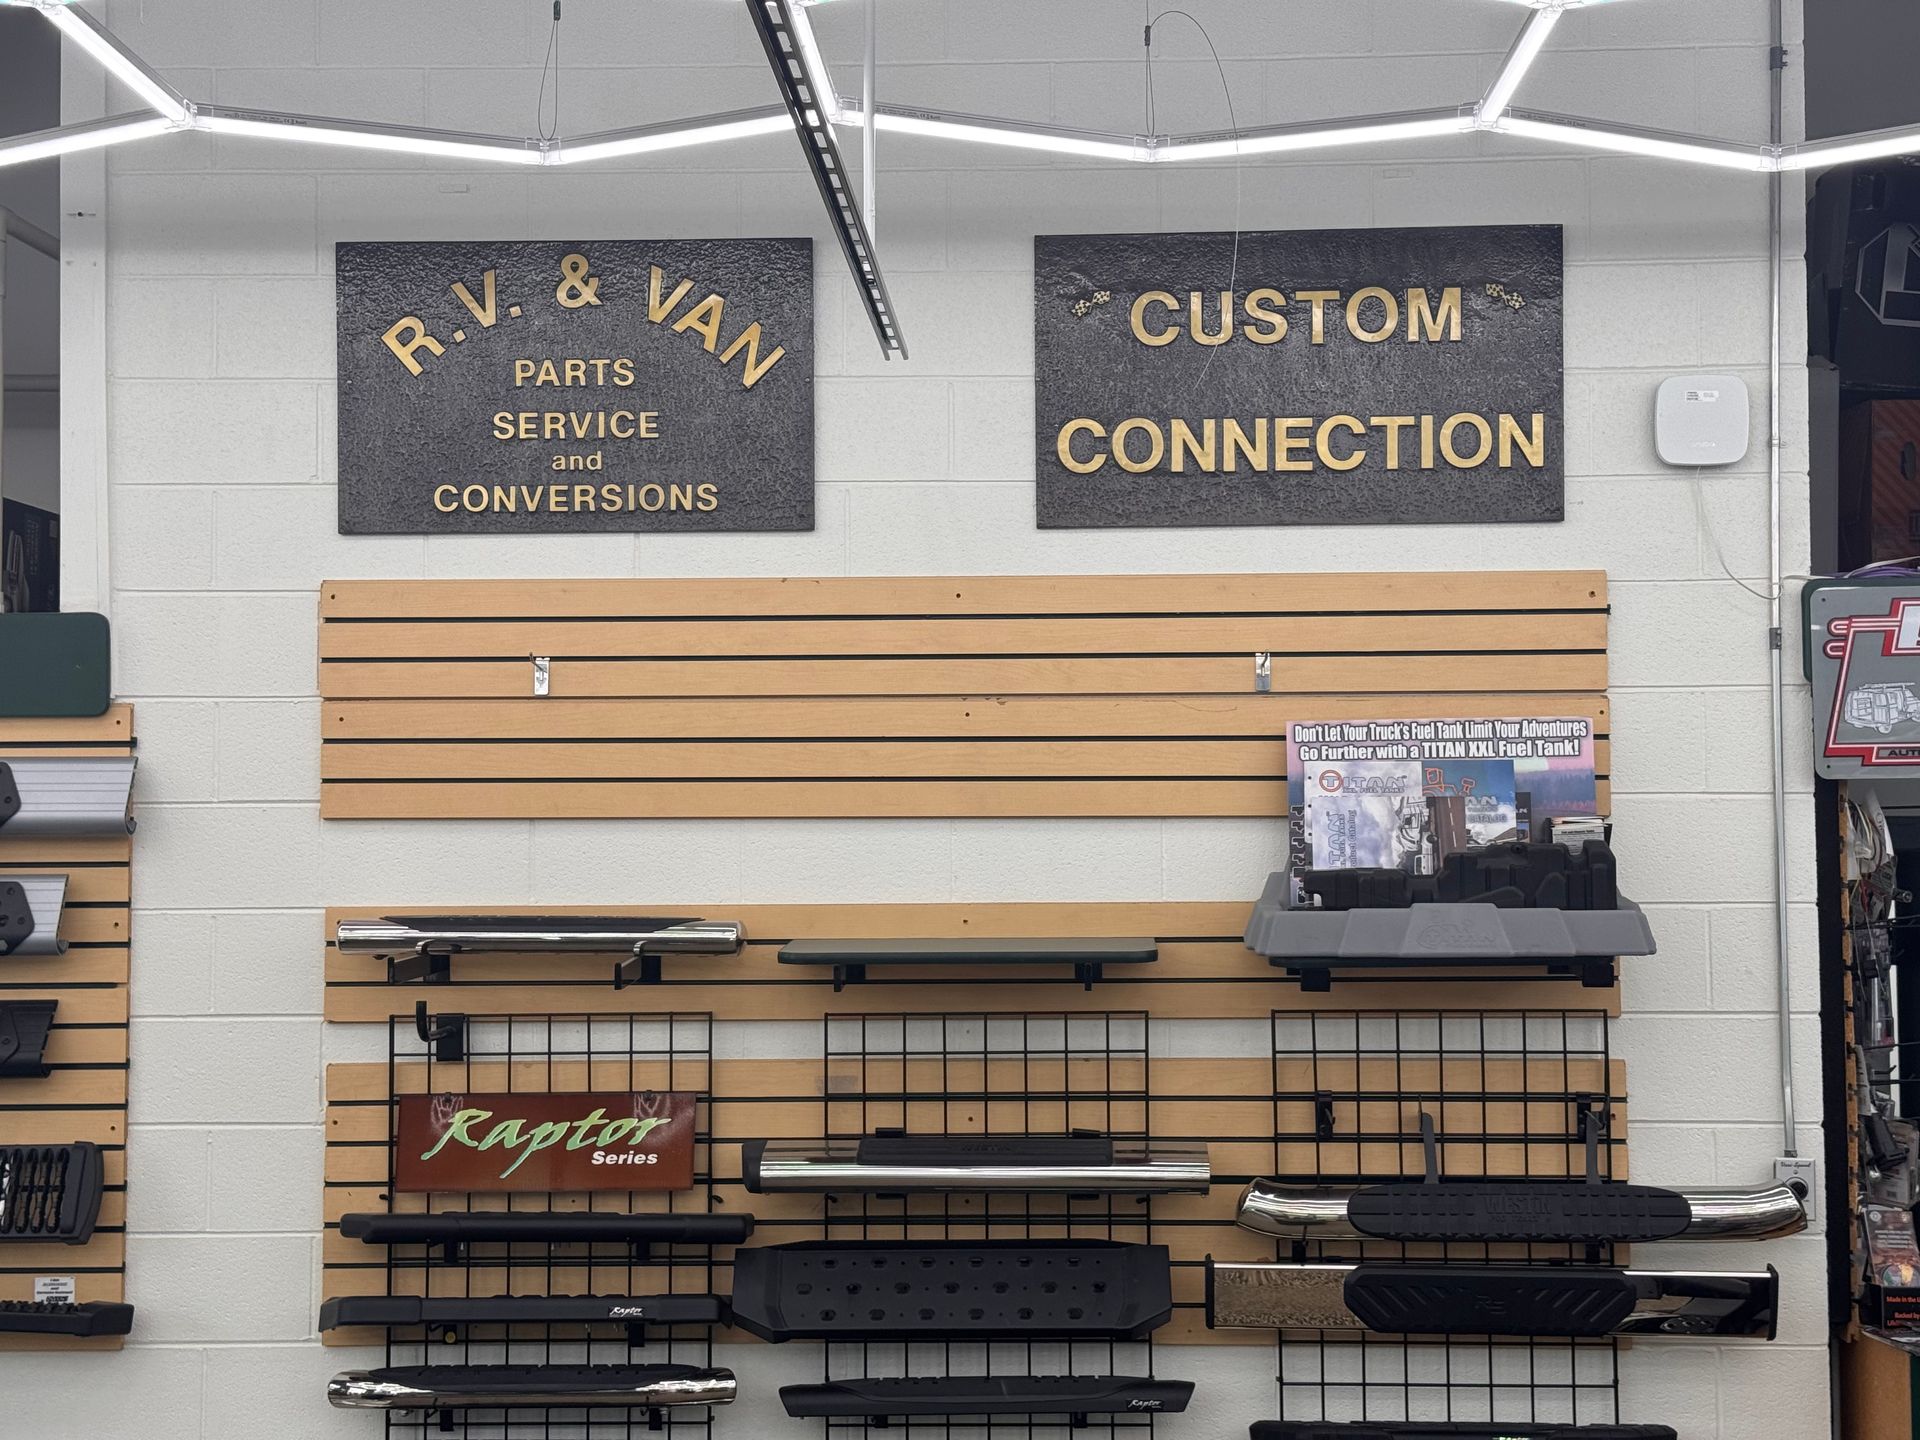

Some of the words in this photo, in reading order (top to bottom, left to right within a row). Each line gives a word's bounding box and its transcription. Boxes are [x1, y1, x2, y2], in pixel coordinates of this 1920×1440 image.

[381, 268, 523, 377] R.V.
[555, 253, 602, 309] &
[648, 264, 786, 390] VAN
[1129, 286, 1463, 347] CUSTOM
[514, 358, 636, 388] PARTS
[492, 410, 660, 441] SERVICE
[1056, 411, 1545, 474] CONNECTION
[551, 450, 603, 472] and
[433, 483, 719, 513] CONVERSIONS
[1294, 724, 1323, 743] Don't
[1324, 724, 1342, 742] Let
[1342, 723, 1368, 742] Your
[1369, 722, 1410, 741] Truck's
[1411, 722, 1435, 740] Fuel
[1436, 721, 1464, 740] Tank
[1465, 720, 1494, 739] Limit
[1494, 720, 1521, 739] Your
[1521, 719, 1588, 738] Adventures
[1299, 746, 1318, 761] Go
[1321, 744, 1374, 761] Further
[1375, 743, 1408, 760] with
[1409, 745, 1421, 759] a
[1421, 741, 1466, 759] TITAN
[1467, 740, 1496, 758] XXL
[1498, 740, 1533, 757] Fuel
[1534, 739, 1581, 757] Tank!
[1319, 769, 1405, 792] TITAN
[421, 1108, 672, 1179] Raptor
[591, 1150, 658, 1166] Series
